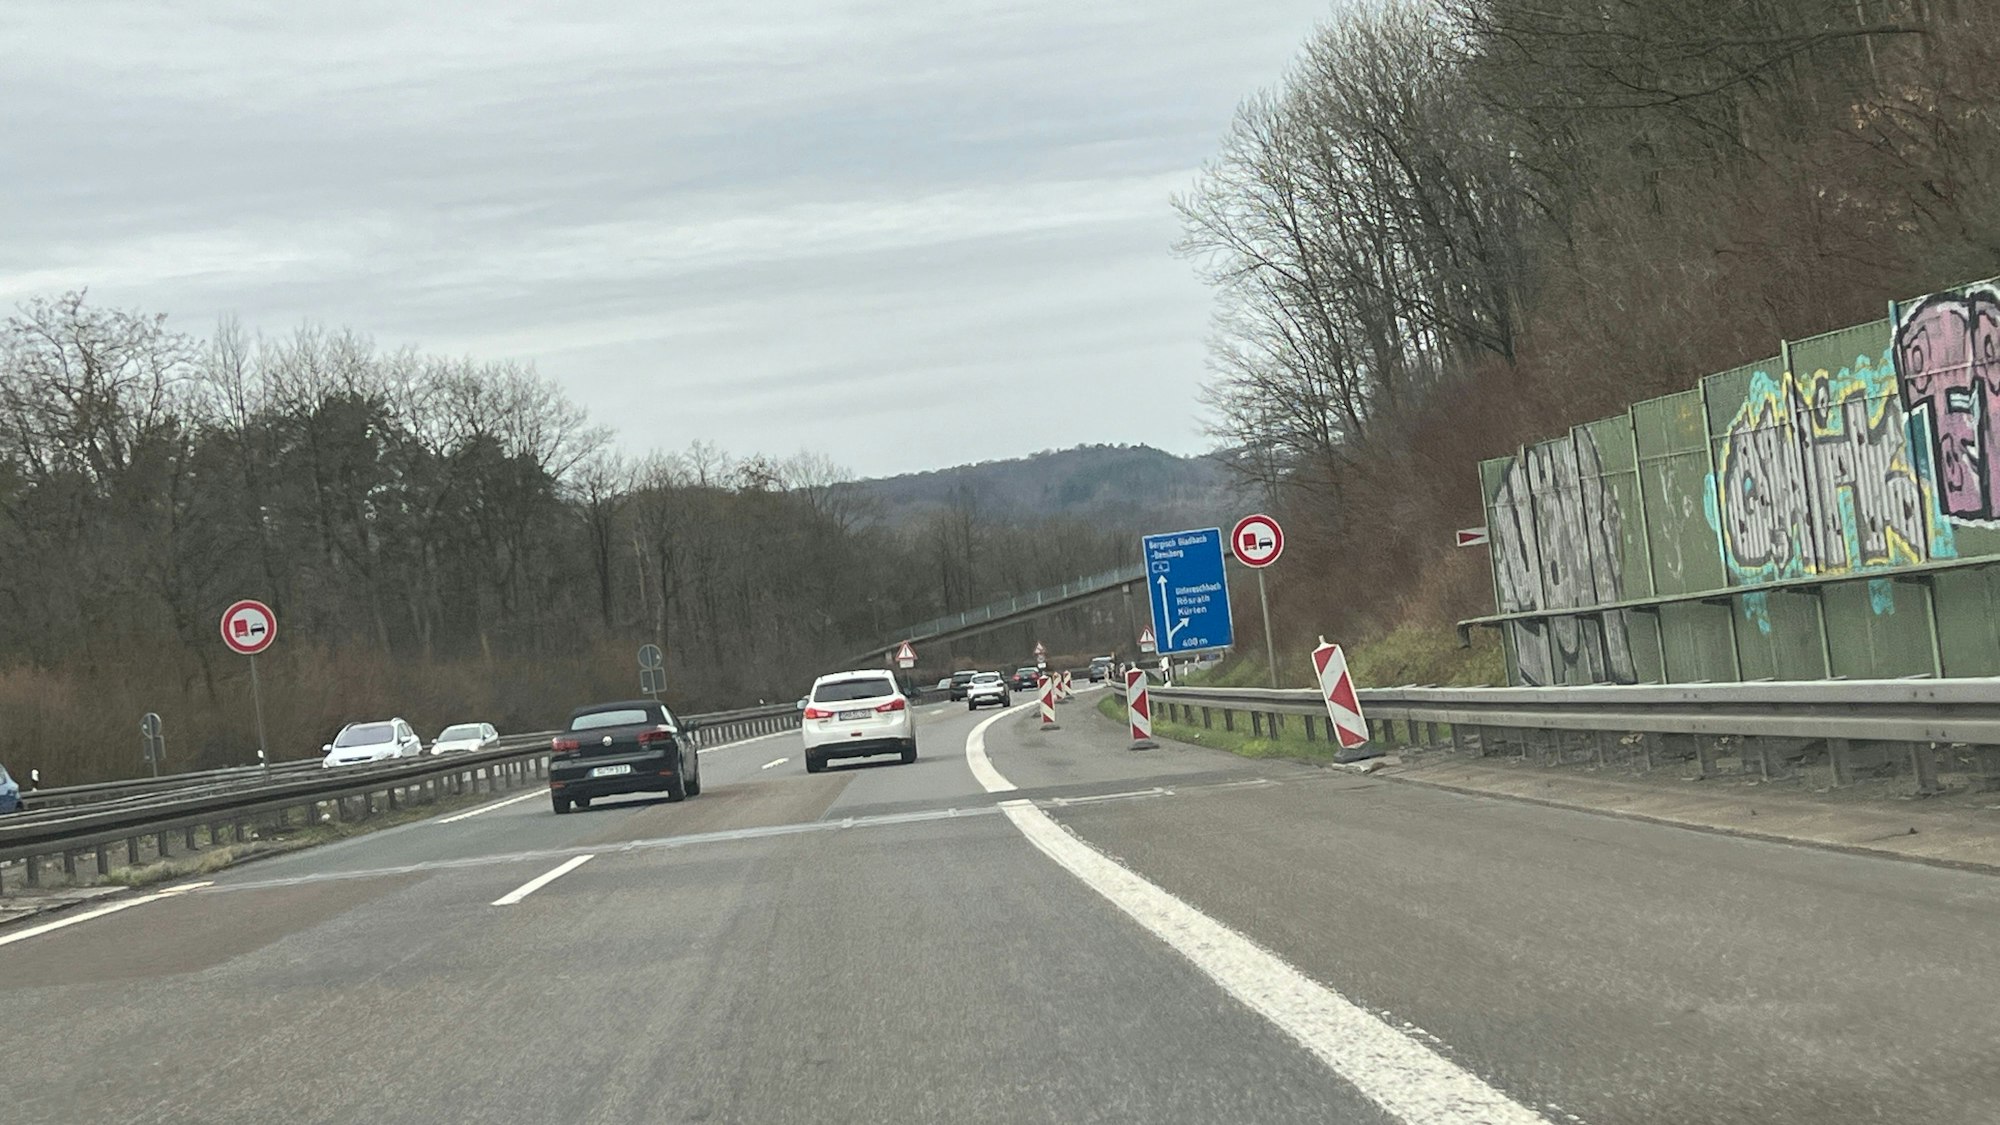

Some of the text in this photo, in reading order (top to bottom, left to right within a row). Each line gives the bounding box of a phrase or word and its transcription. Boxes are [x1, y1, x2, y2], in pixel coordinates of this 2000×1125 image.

[1177, 535, 1207, 546] Gladbach
[1176, 595, 1211, 606] Rösrath
[1178, 606, 1208, 616] Kürten
[1182, 637, 1199, 647] 400
